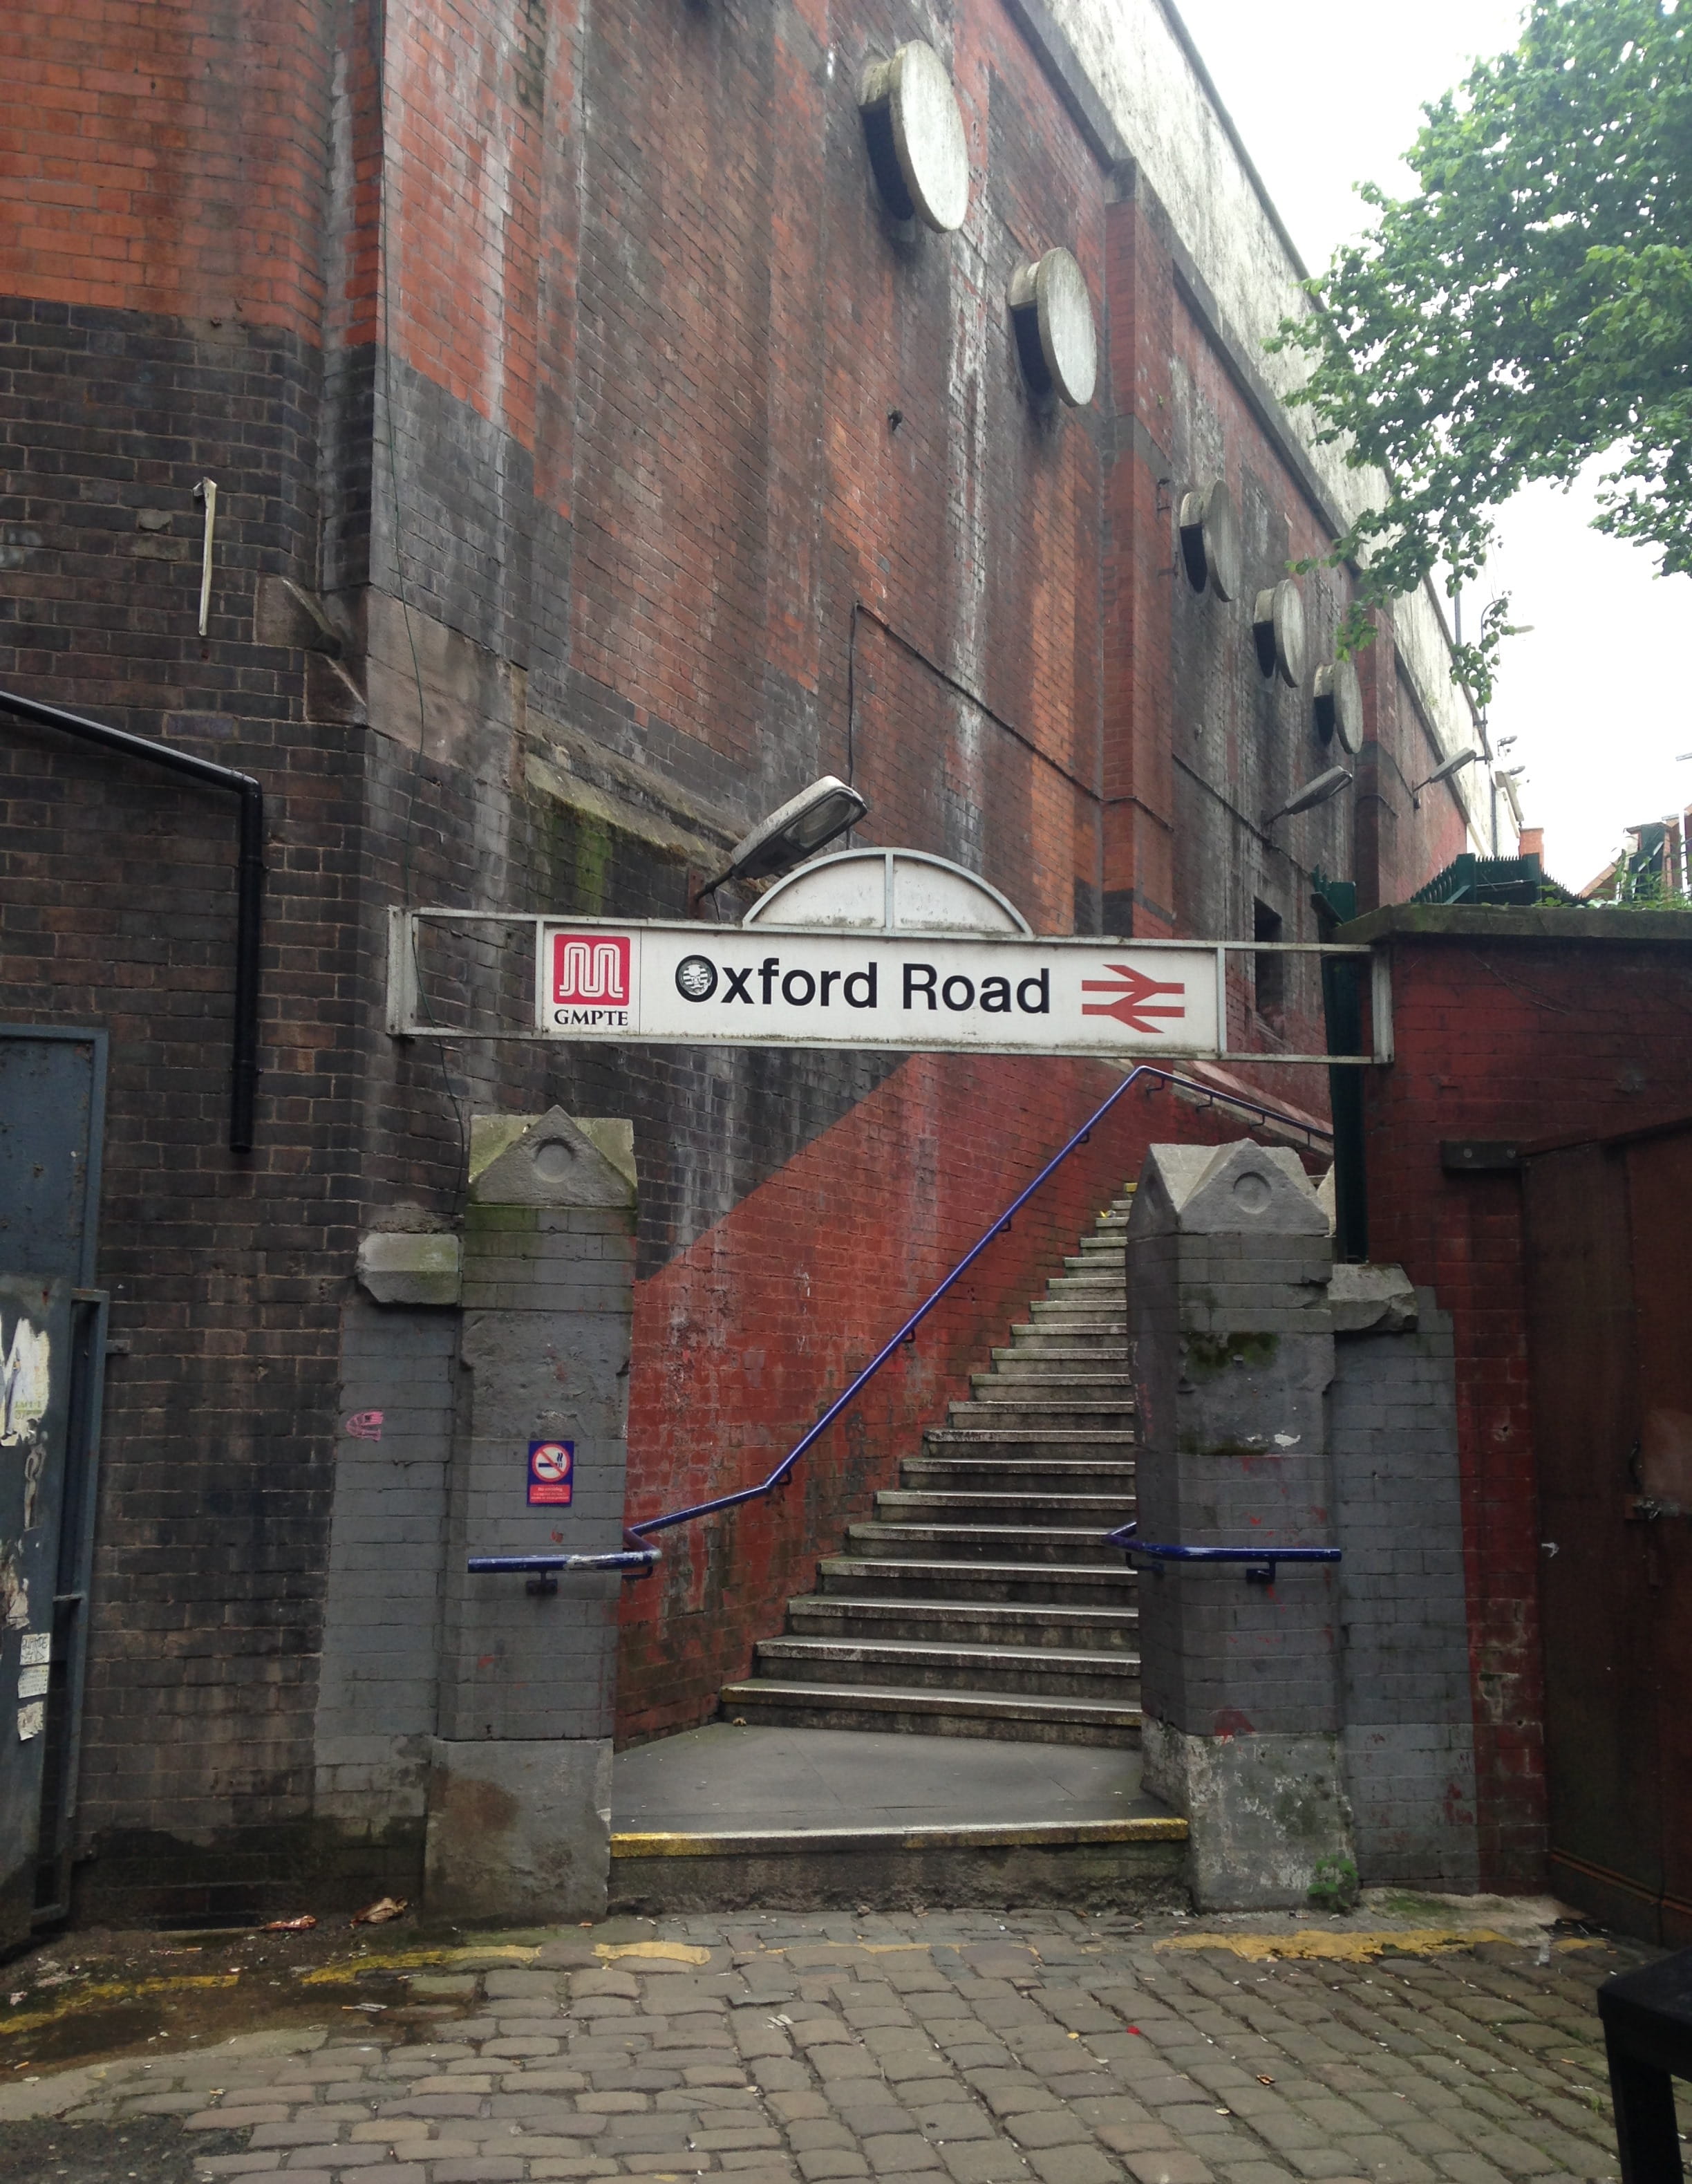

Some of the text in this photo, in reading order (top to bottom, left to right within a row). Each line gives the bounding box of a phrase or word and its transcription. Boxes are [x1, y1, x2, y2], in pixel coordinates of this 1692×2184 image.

[675, 955, 1050, 1014] Oxford Road
[554, 1009, 628, 1026] GMPTE
